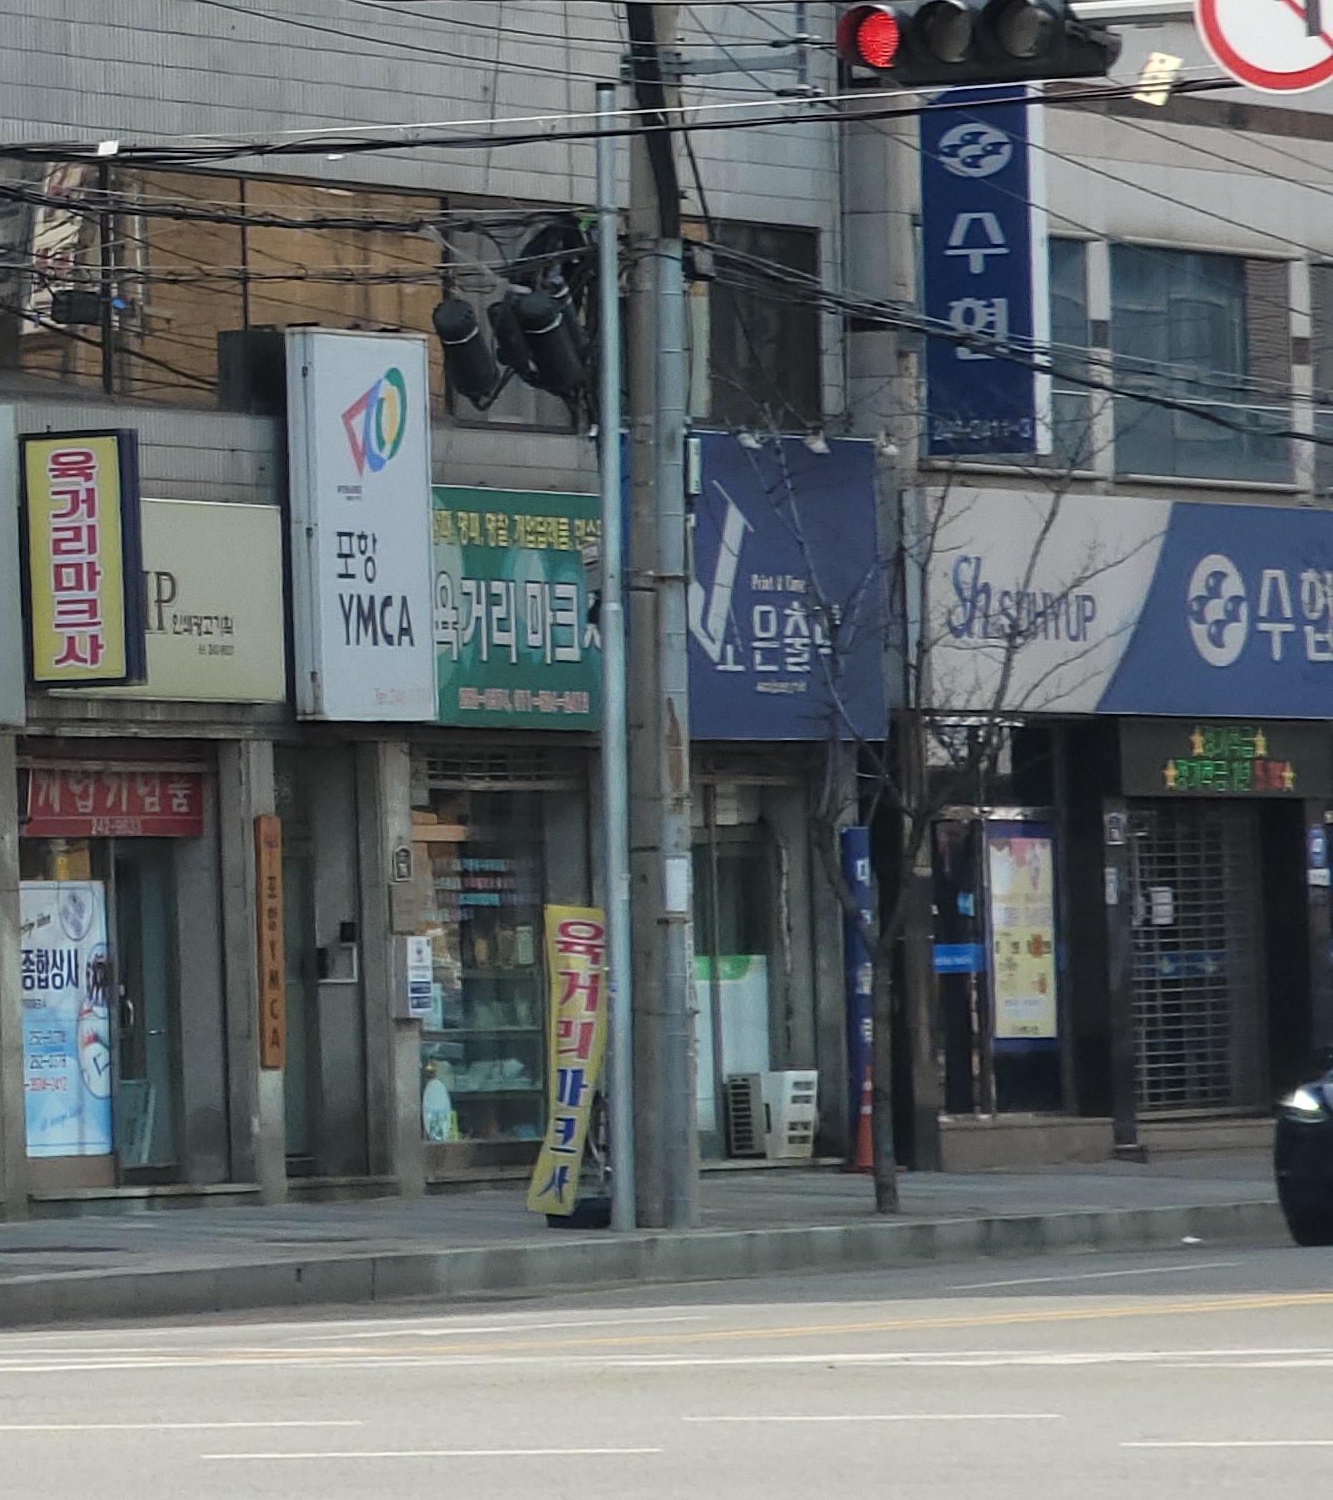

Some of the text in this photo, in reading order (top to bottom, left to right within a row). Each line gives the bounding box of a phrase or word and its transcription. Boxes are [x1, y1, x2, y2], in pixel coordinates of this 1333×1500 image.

[943, 211, 1010, 361] 수협
[47, 448, 105, 668] 육거리마크사
[335, 530, 378, 584] 포항
[338, 593, 415, 648] YMCA
